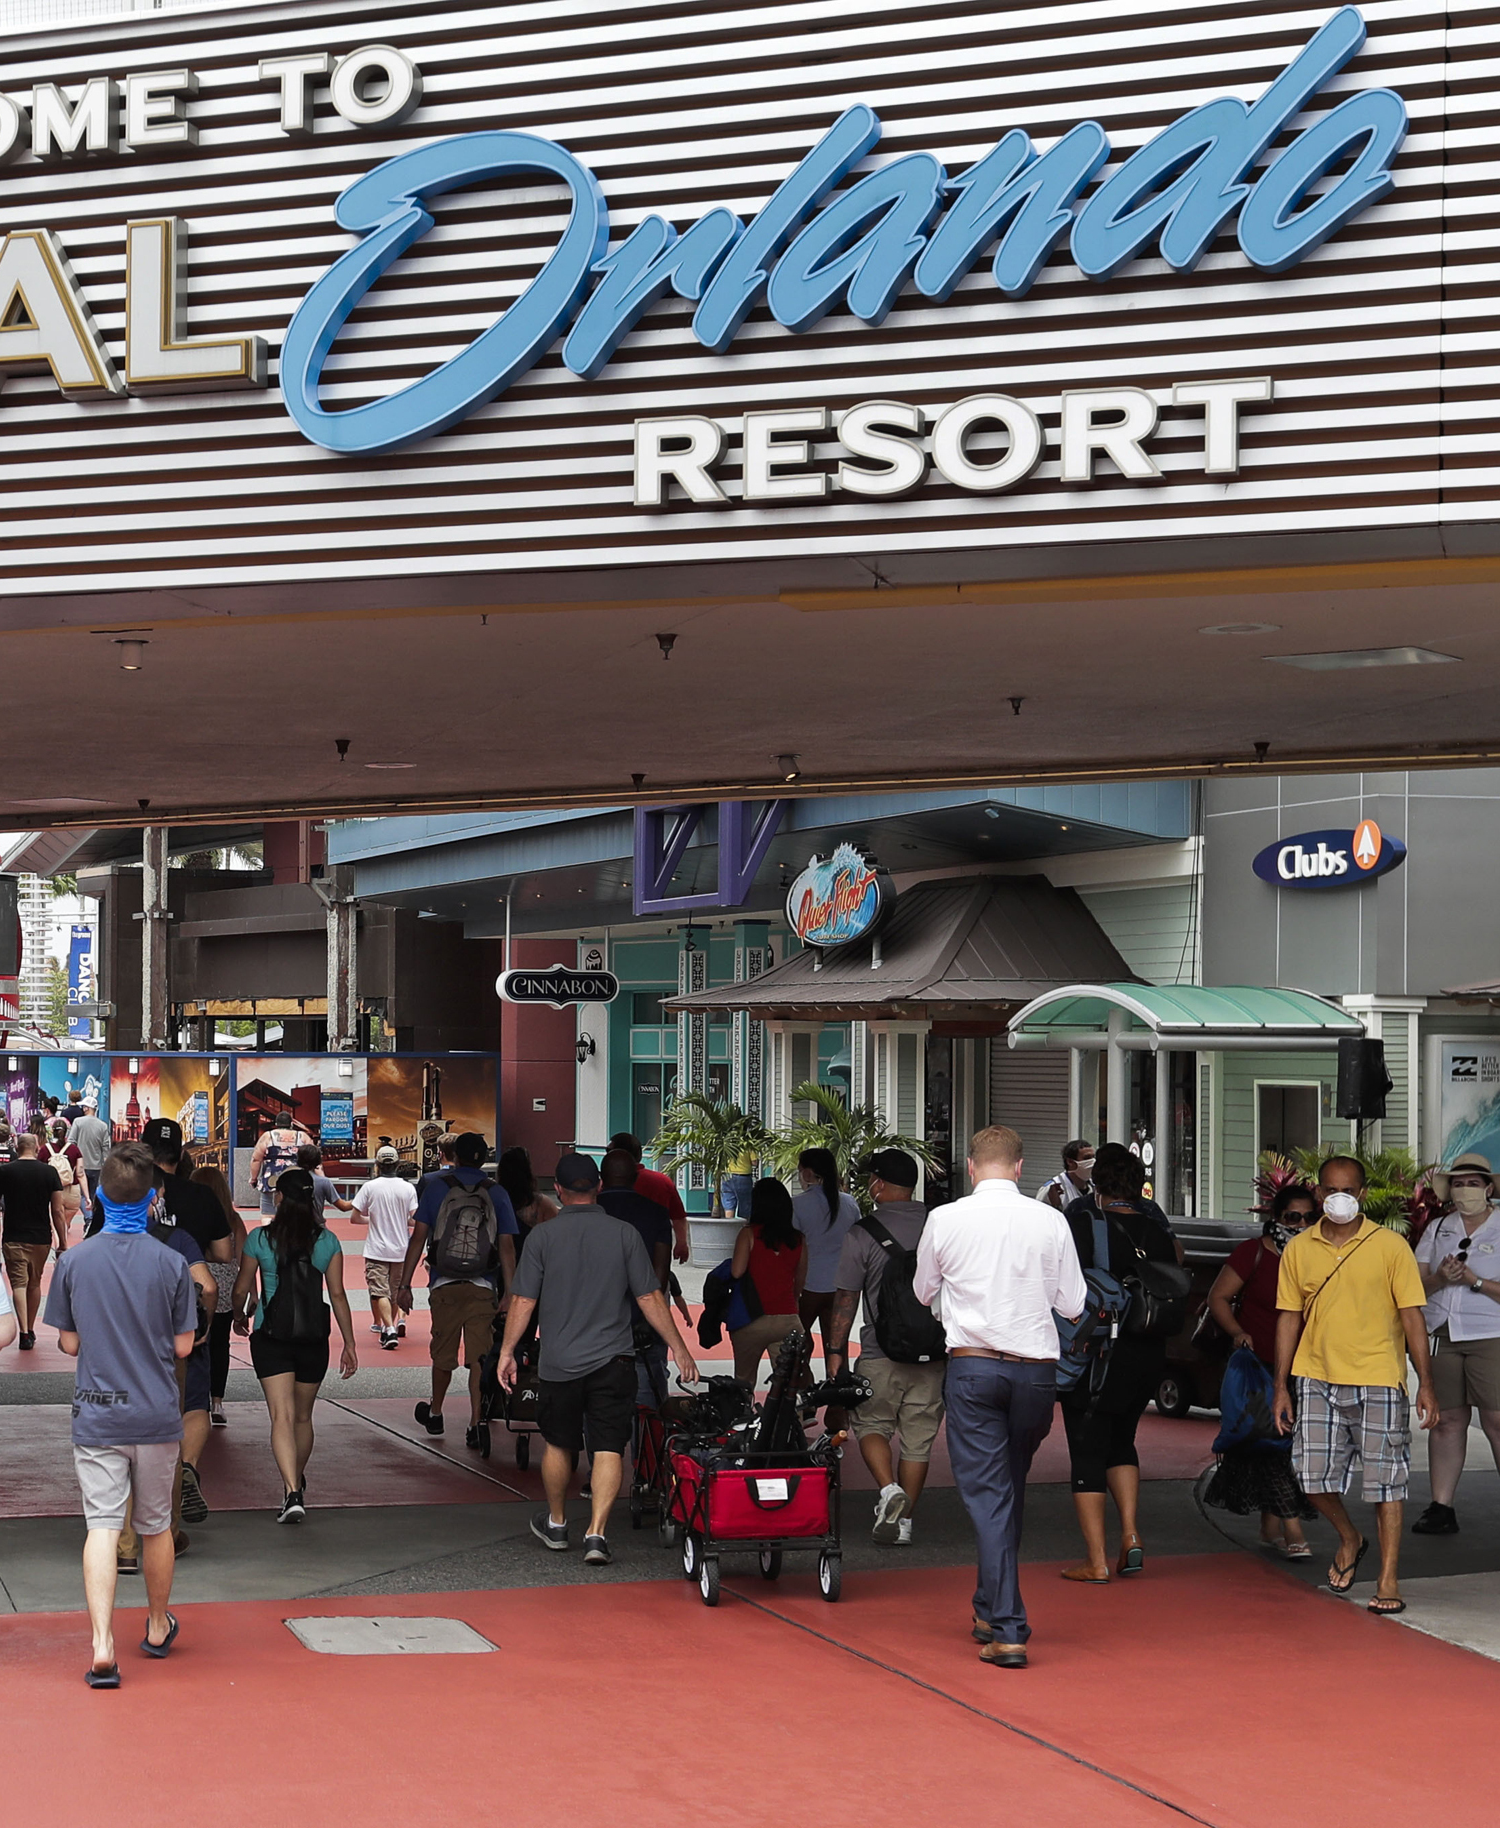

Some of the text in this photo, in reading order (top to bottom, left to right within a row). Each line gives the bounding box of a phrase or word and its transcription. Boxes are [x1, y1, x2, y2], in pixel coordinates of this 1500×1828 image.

[259, 43, 424, 138] TO
[277, 3, 1410, 456] Orlando
[632, 374, 1274, 509] RESORT
[1277, 842, 1348, 880] Clubs
[796, 866, 877, 948] Quiet Flight
[78, 953, 91, 1004] DANC
[512, 977, 609, 995] CINNABON
[67, 987, 78, 1026] CLB
[74, 1386, 128, 1404] UNNER
